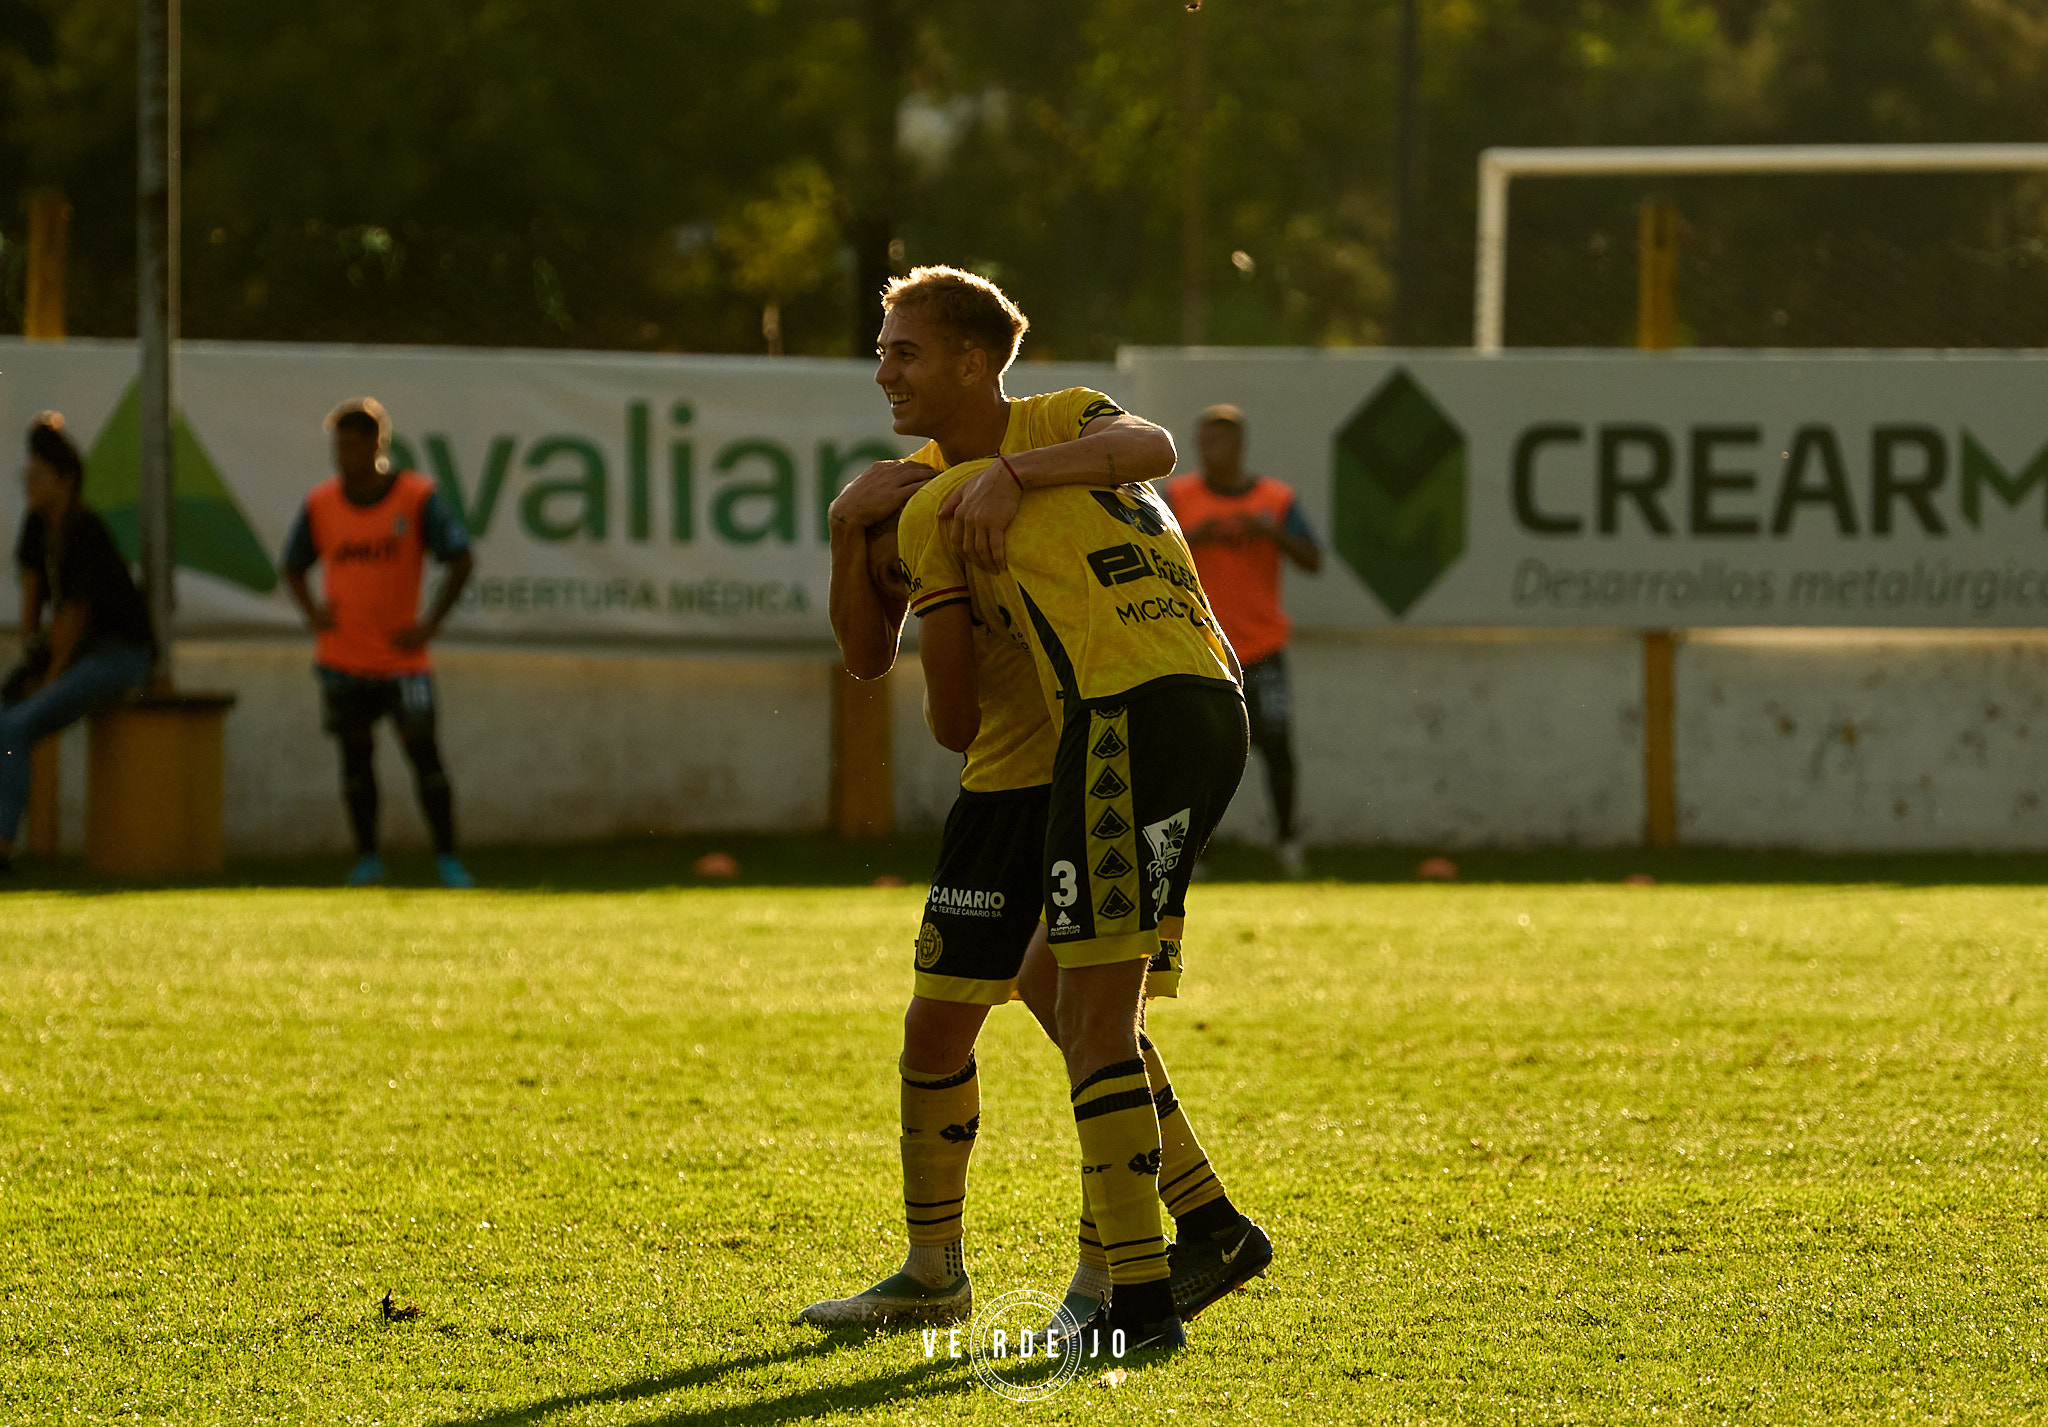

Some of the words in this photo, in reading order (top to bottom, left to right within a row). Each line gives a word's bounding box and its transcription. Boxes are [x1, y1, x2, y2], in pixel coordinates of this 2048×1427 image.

[390, 400, 903, 545] valian
[1511, 557, 1774, 609] Desarrollos
[1051, 860, 1078, 907] 3
[961, 908, 990, 918] CANARIO
[991, 910, 1002, 918] SA
